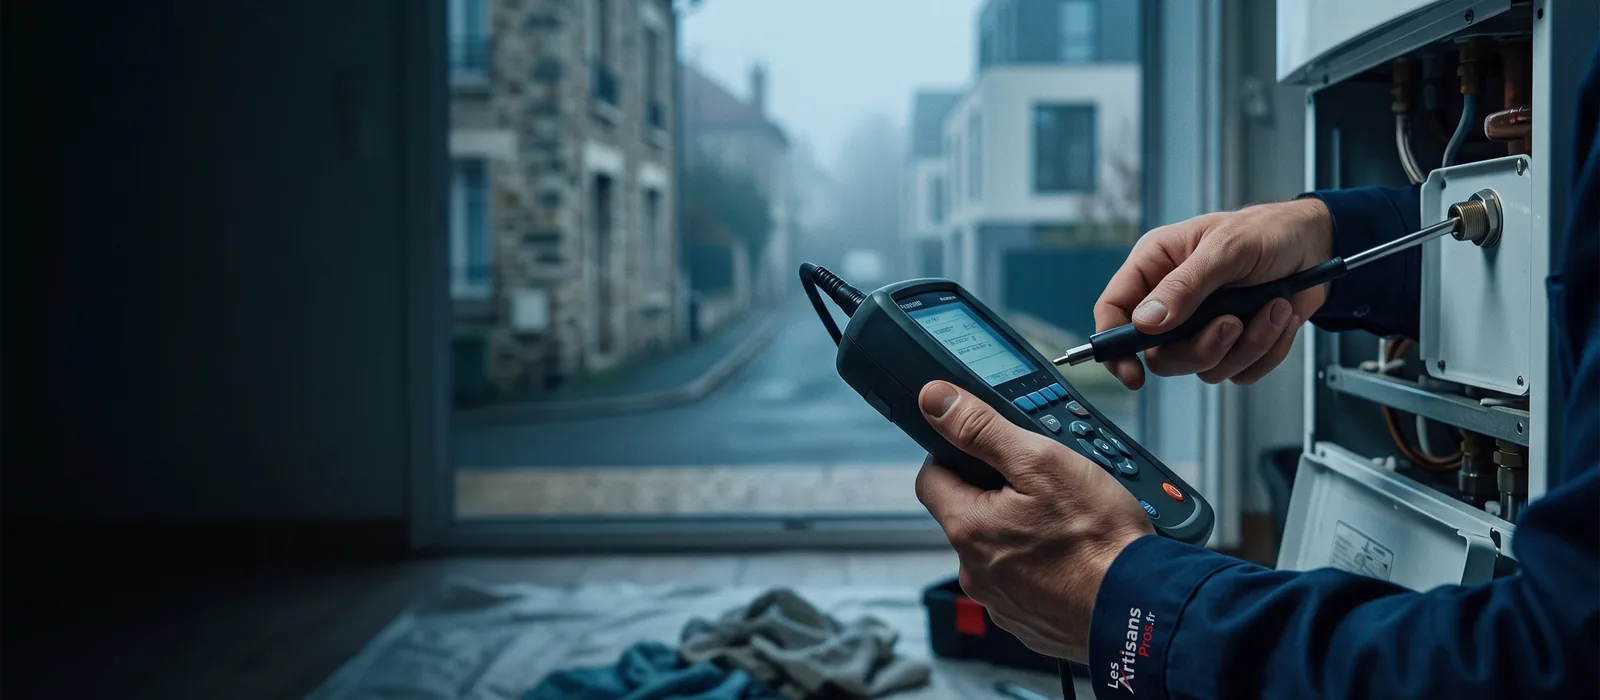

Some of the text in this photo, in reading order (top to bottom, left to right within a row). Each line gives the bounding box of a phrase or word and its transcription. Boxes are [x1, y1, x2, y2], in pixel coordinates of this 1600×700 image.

[1118, 607, 1141, 694] Artisans
[1138, 611, 1155, 657] Pros.fr
[1107, 661, 1119, 689] Les
